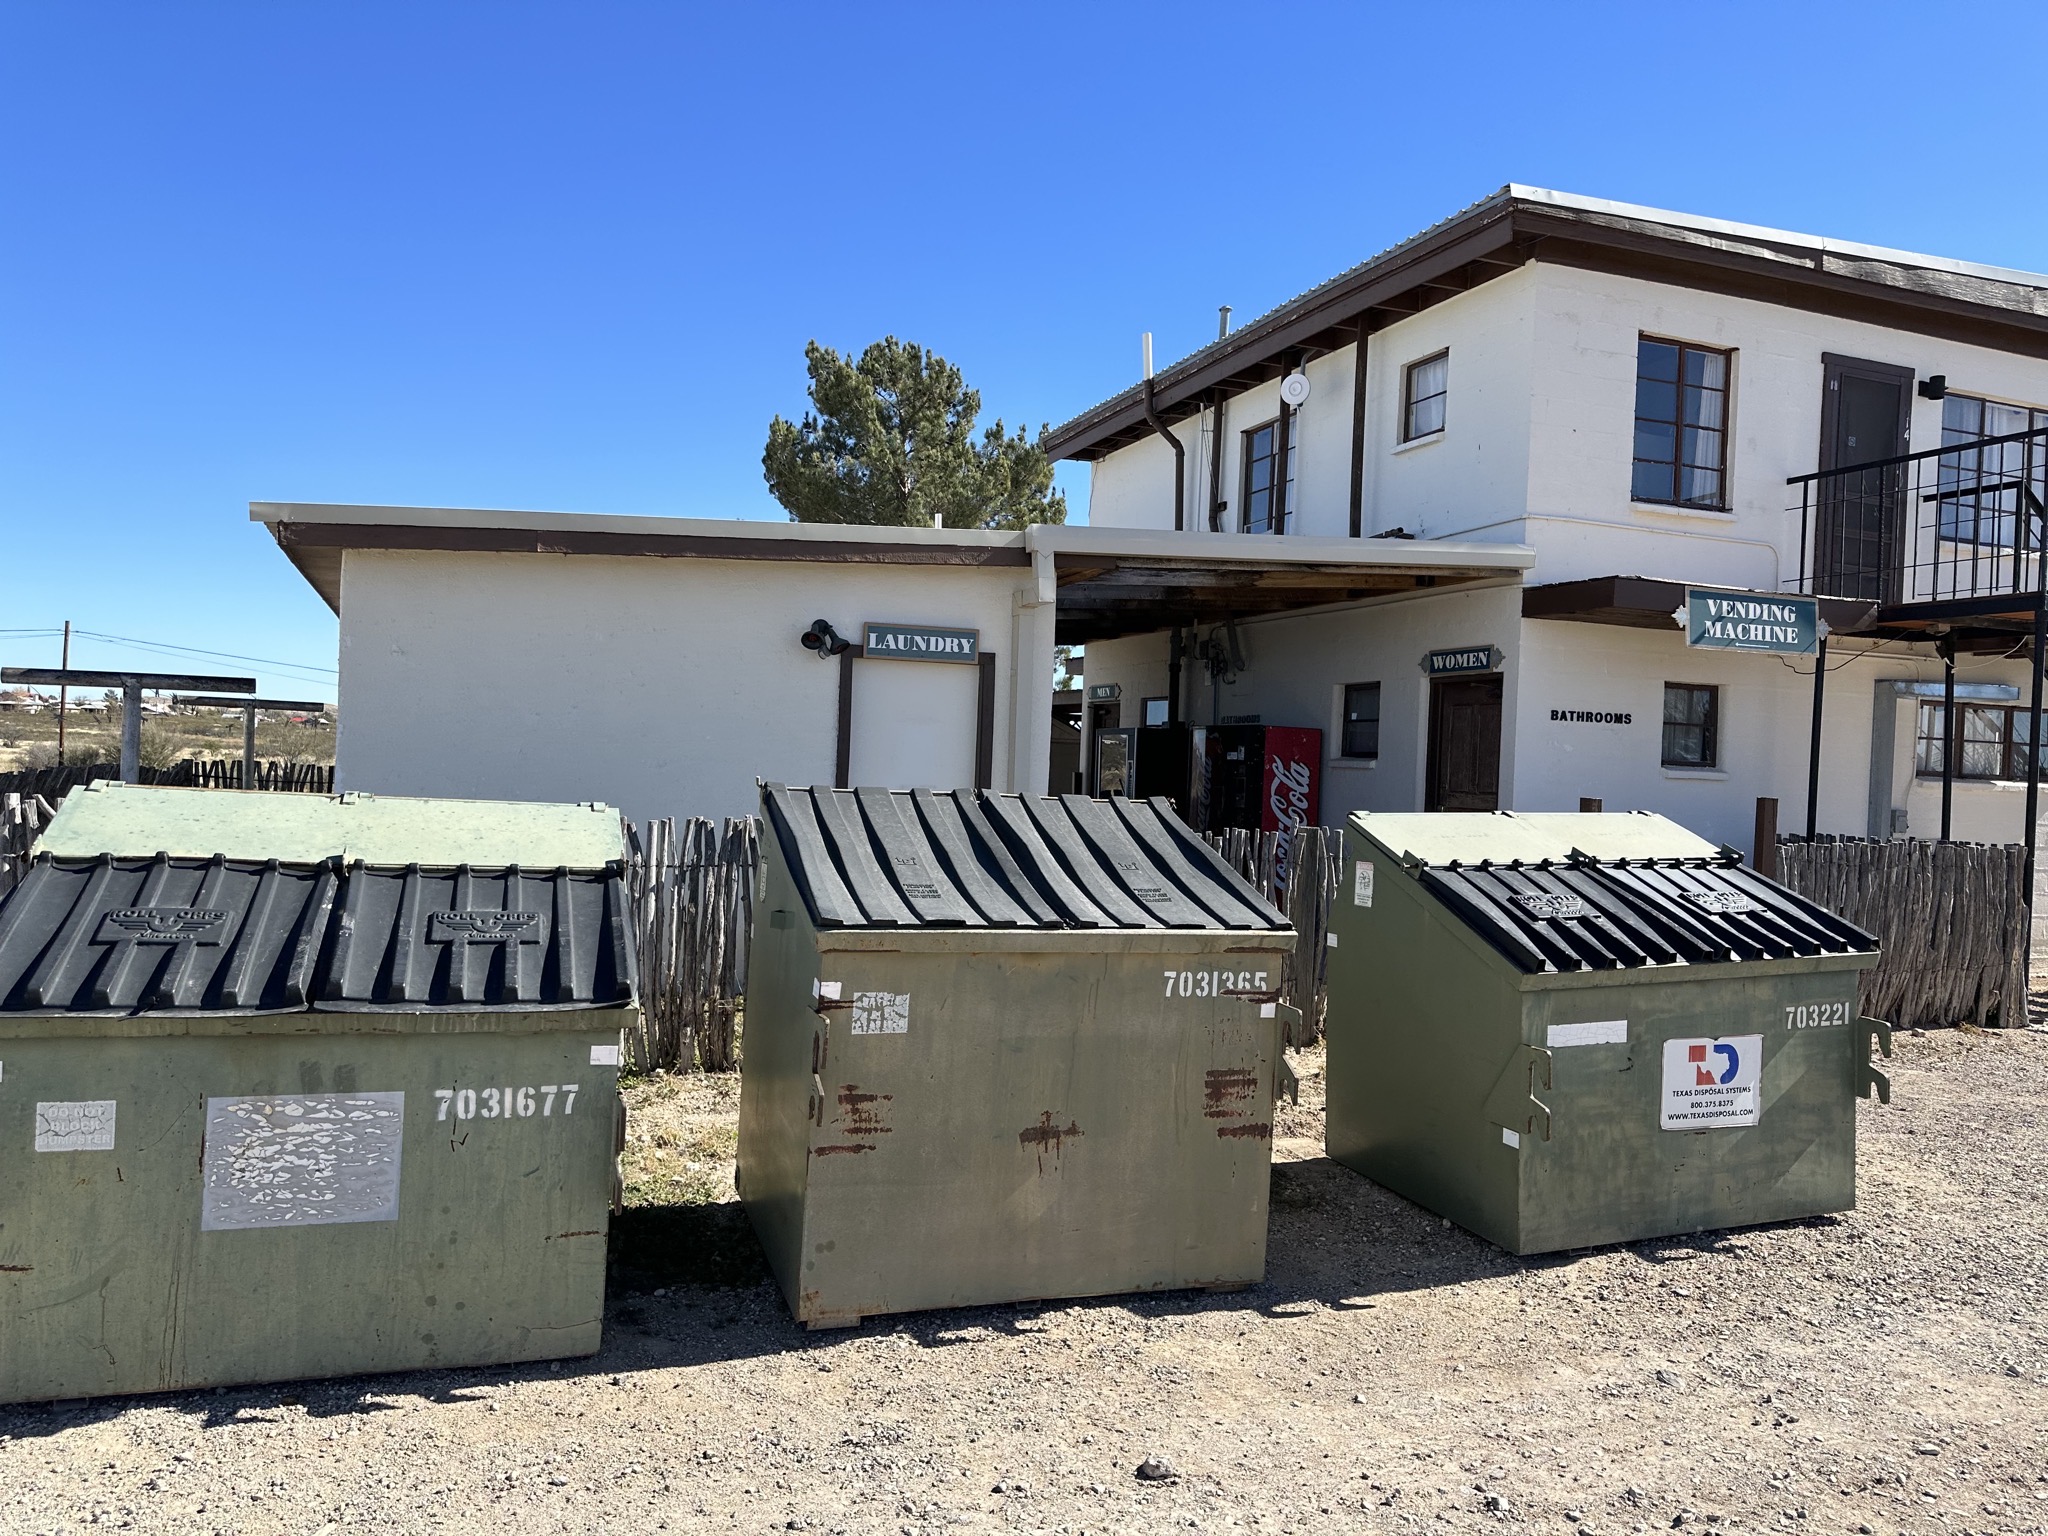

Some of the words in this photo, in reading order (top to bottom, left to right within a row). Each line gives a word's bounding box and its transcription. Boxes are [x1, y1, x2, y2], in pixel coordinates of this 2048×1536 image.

[1706, 598, 1797, 623] VENDING
[1704, 620, 1798, 644] MACHINE
[868, 632, 974, 654] LAUNDRY
[1432, 651, 1489, 670] WOMEN
[1097, 687, 1110, 697] MEN
[1550, 709, 1632, 725] BATHROOMS
[435, 912, 479, 921] ROLL
[1785, 1001, 1850, 1030] 703221
[1672, 1089, 1693, 1097] TEXAS
[1694, 1087, 1724, 1096] DISPOSAL
[1725, 1086, 1751, 1094] SYSTEMS
[434, 1084, 579, 1121] 7031677
[1690, 1099, 1734, 1109] 800.375.8375
[48, 1107, 69, 1118] DO
[1667, 1108, 1754, 1121] WWW.TEXASDISPOSAL.COM
